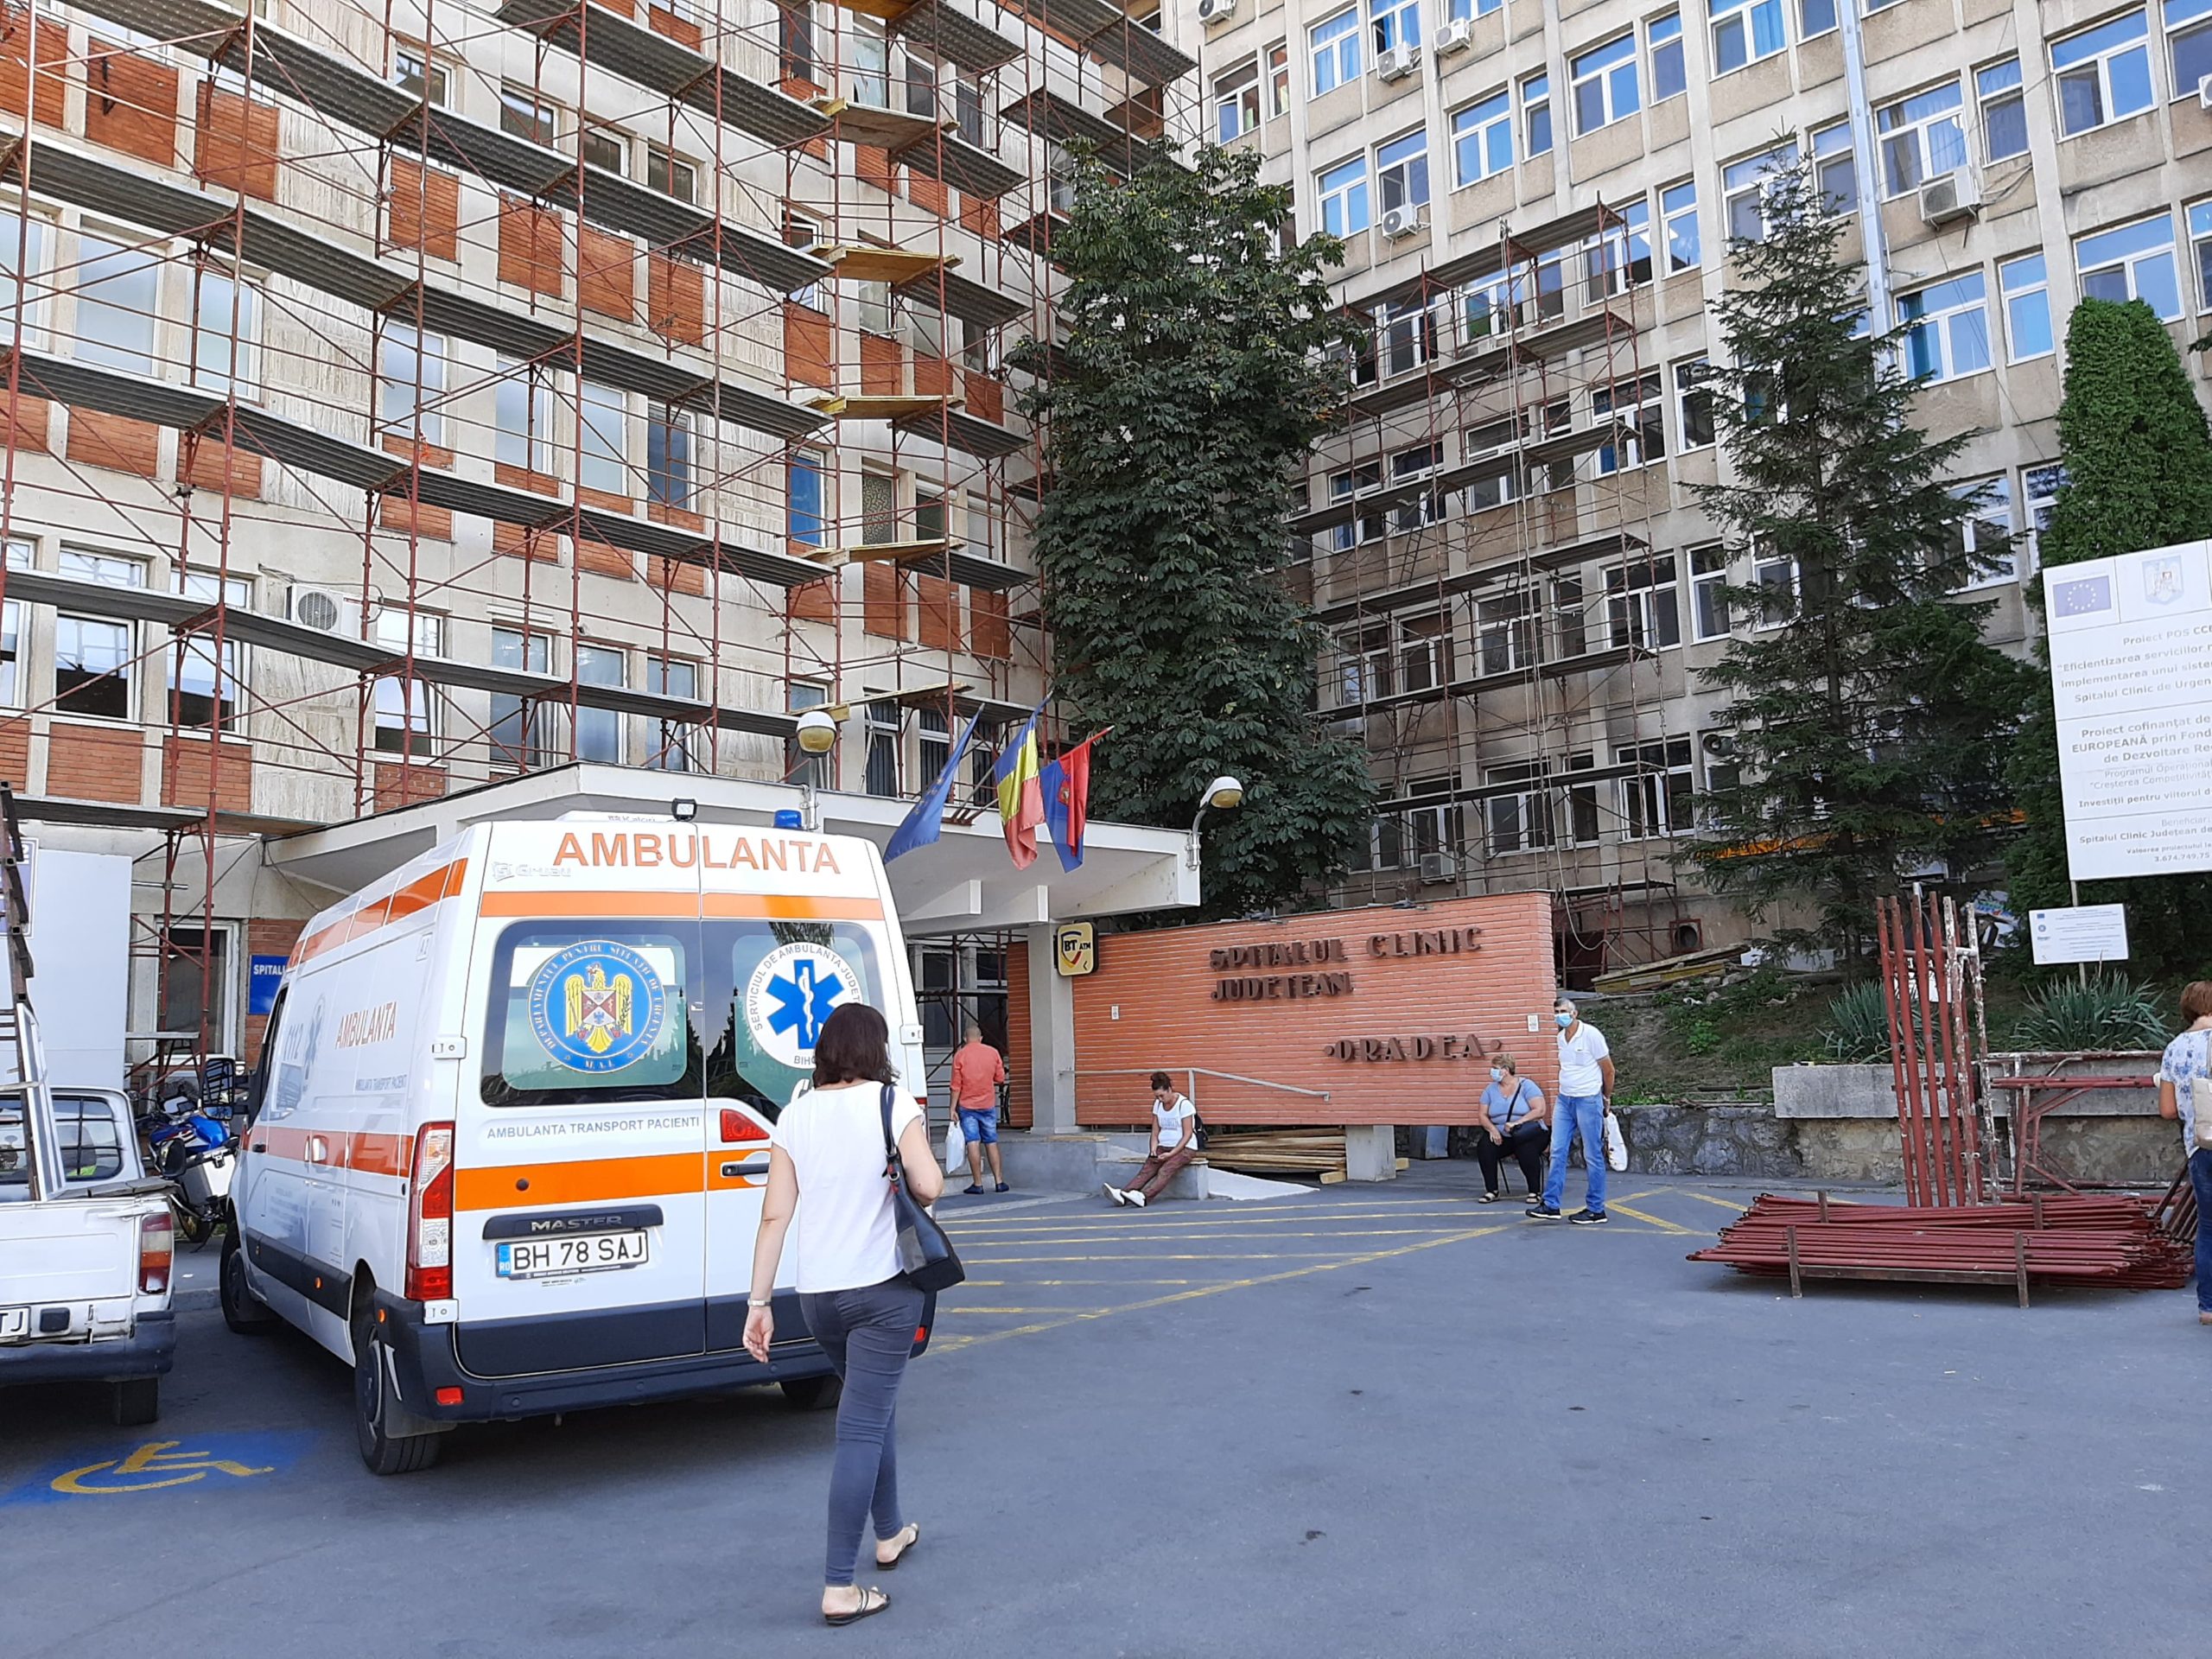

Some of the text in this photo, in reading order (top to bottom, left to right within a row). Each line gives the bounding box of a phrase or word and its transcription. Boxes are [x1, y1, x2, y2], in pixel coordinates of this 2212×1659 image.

[2075, 688, 2118, 703] Spitalul
[2121, 684, 2154, 696] Clinic
[2082, 725, 2124, 738] Proiect
[2152, 732, 2177, 746] prin
[2104, 753, 2119, 763] de
[2123, 746, 2190, 761] Dezvoltare
[2127, 793, 2161, 804] pentru
[2164, 787, 2201, 799] viitorul
[2080, 833, 2117, 844] Spitalul
[2120, 830, 2147, 841] Clinic
[553, 832, 841, 874] AMBULANTA
[1064, 939, 1077, 951] BT
[1210, 926, 1482, 970] SPITALUL CLINIC
[749, 944, 861, 1031] SERVICIUL DE AMBULANTA JUDET
[1211, 971, 1355, 1001] JUDETEAN
[335, 1001, 397, 1050] AMBULANTA
[486, 1116, 700, 1139] AMBULANTA TRANSPORT PACIENTI
[531, 1216, 622, 1232] MASTER
[514, 1236, 642, 1271] BH 78 SAJ
[499, 1262, 511, 1272] RO
